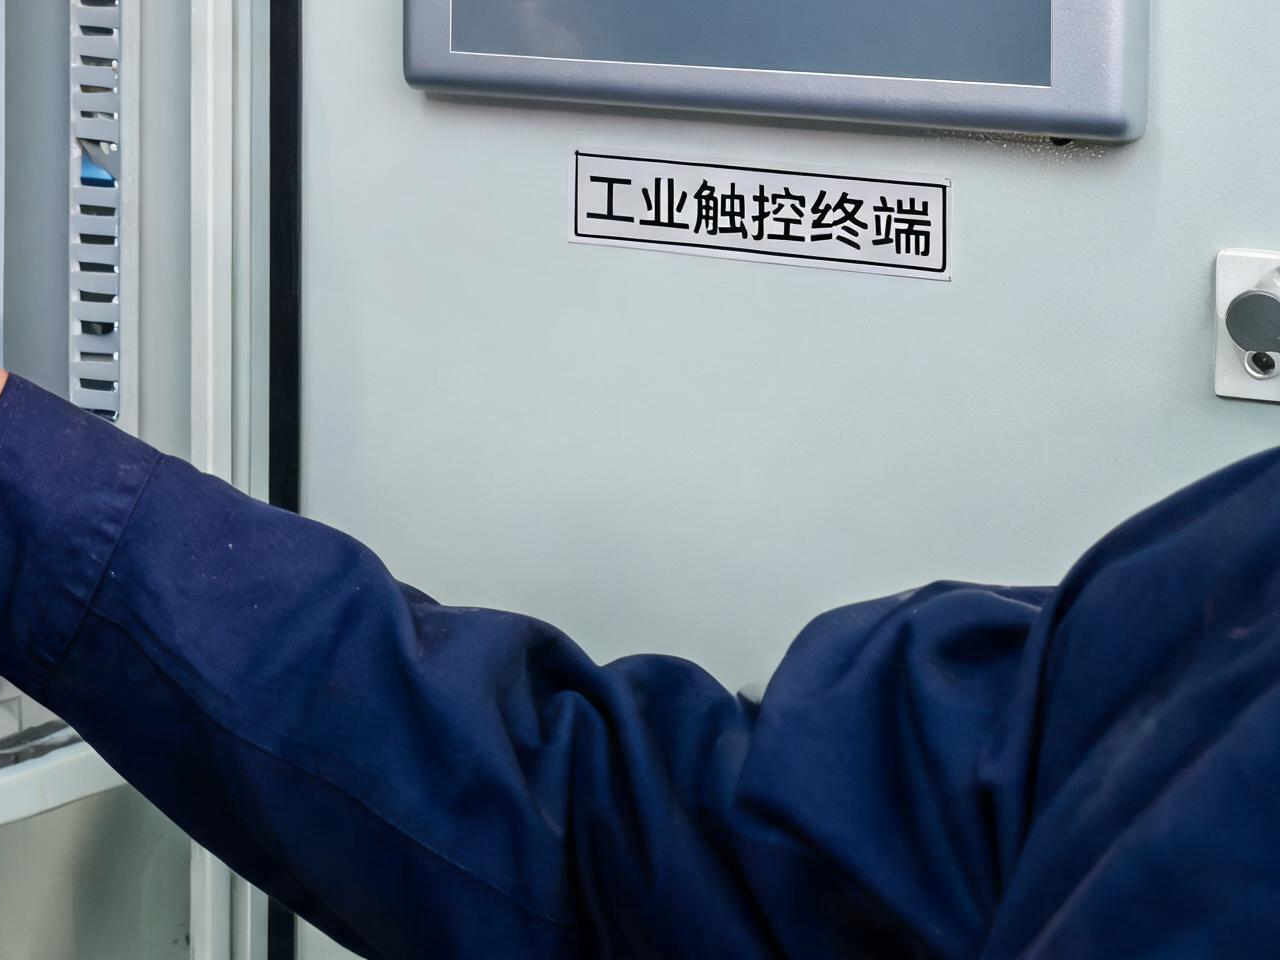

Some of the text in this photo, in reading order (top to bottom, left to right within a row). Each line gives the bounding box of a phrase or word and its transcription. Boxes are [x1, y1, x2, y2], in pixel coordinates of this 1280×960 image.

[586, 175, 932, 257] 工业触控终端
